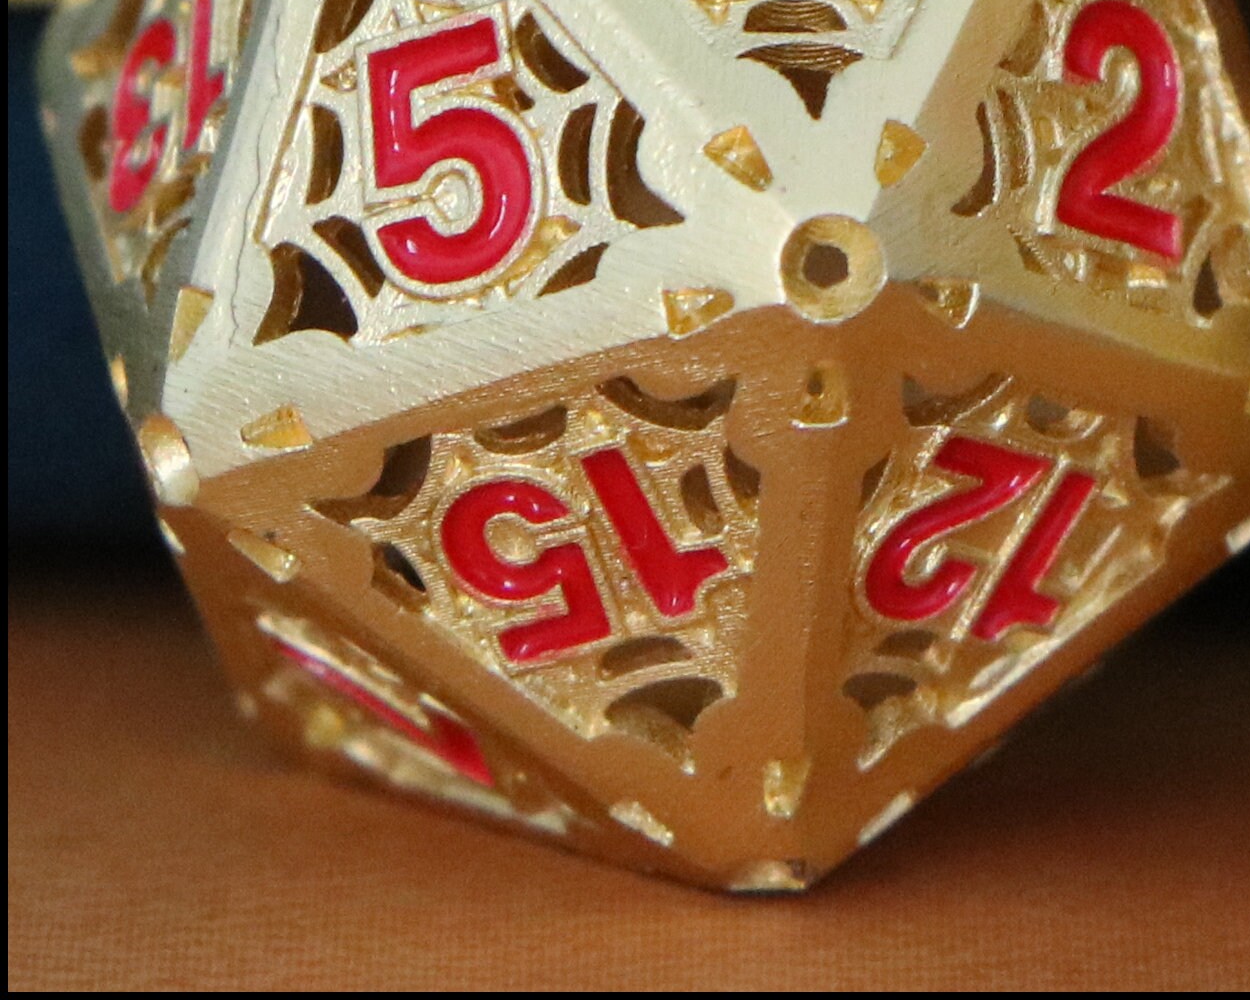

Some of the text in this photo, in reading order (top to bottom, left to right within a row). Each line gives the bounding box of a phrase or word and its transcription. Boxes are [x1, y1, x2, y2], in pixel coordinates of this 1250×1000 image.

[369, 17, 532, 283] 5
[441, 447, 728, 663] 15
[865, 436, 1096, 641] 12
